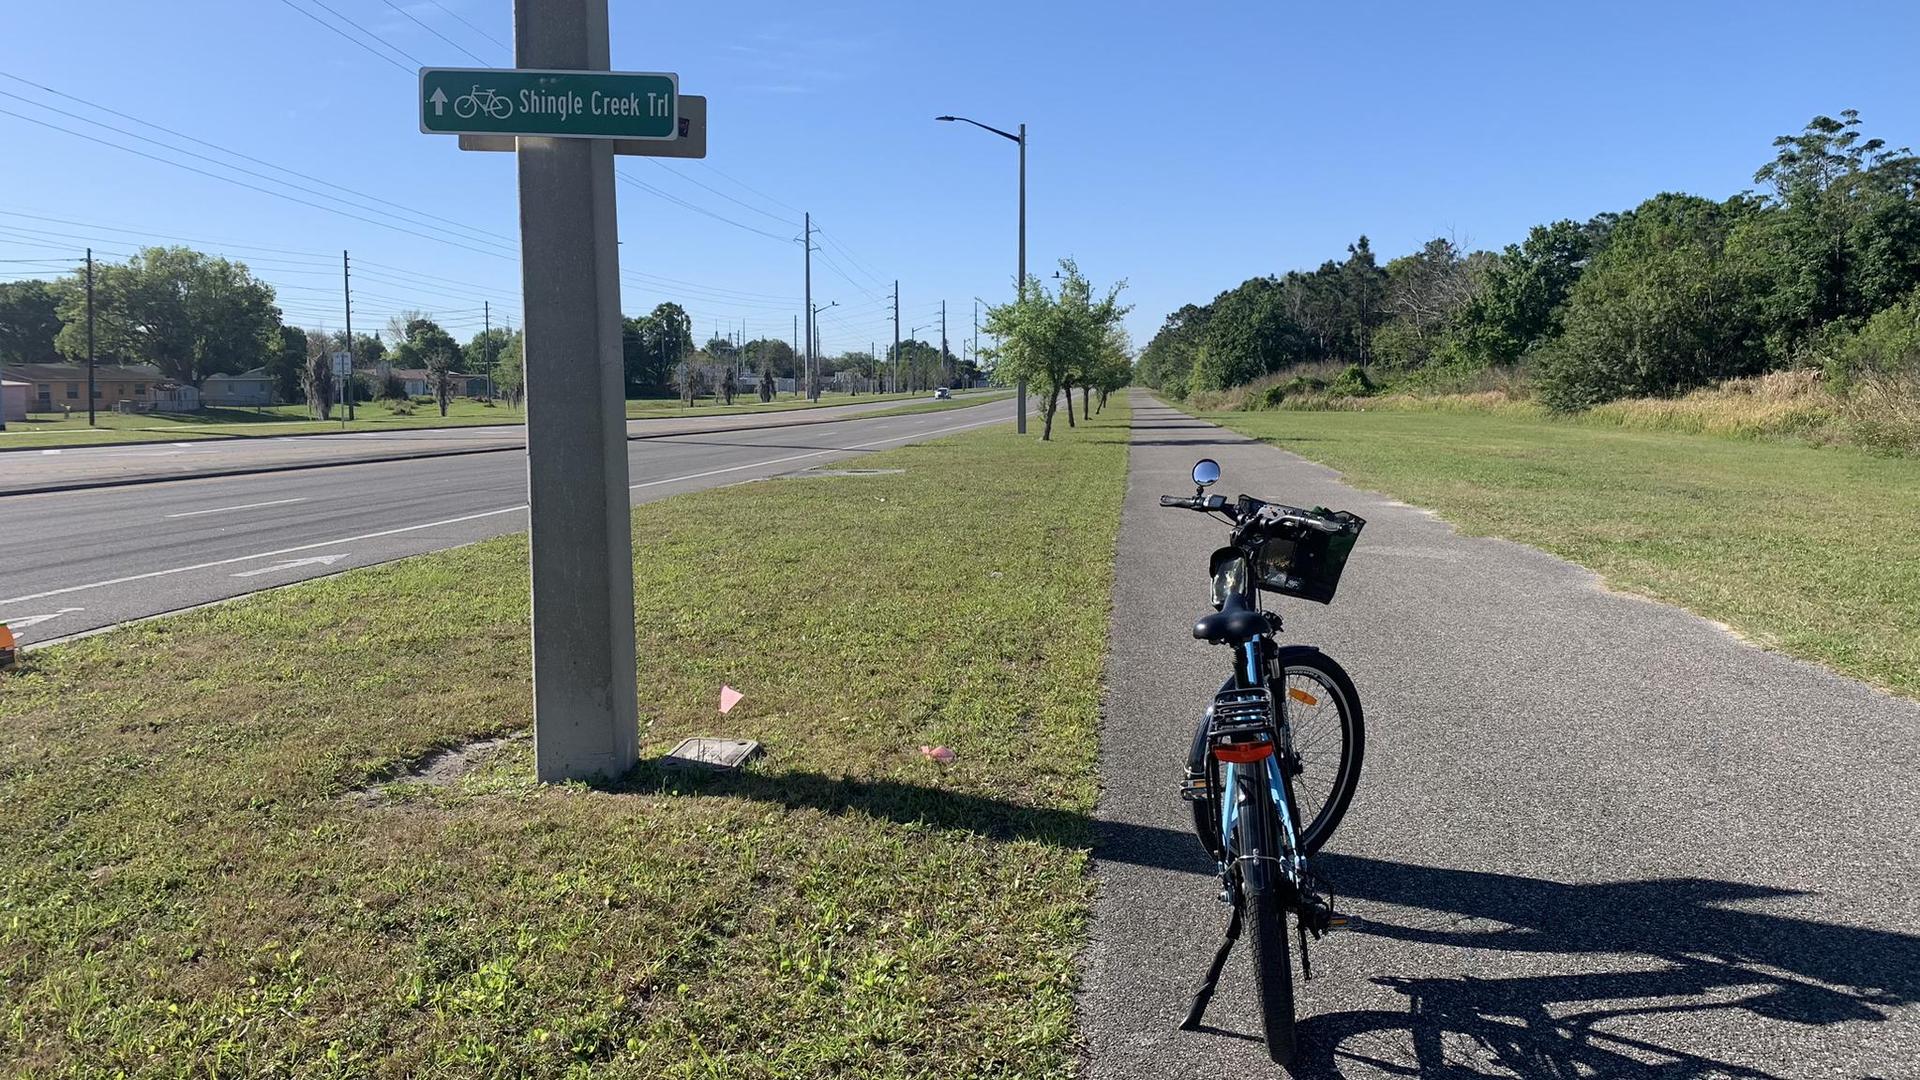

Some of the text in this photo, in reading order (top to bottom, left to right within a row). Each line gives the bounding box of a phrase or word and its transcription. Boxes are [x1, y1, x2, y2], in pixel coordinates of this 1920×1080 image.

[519, 89, 669, 121] Shingle Creek Trl
